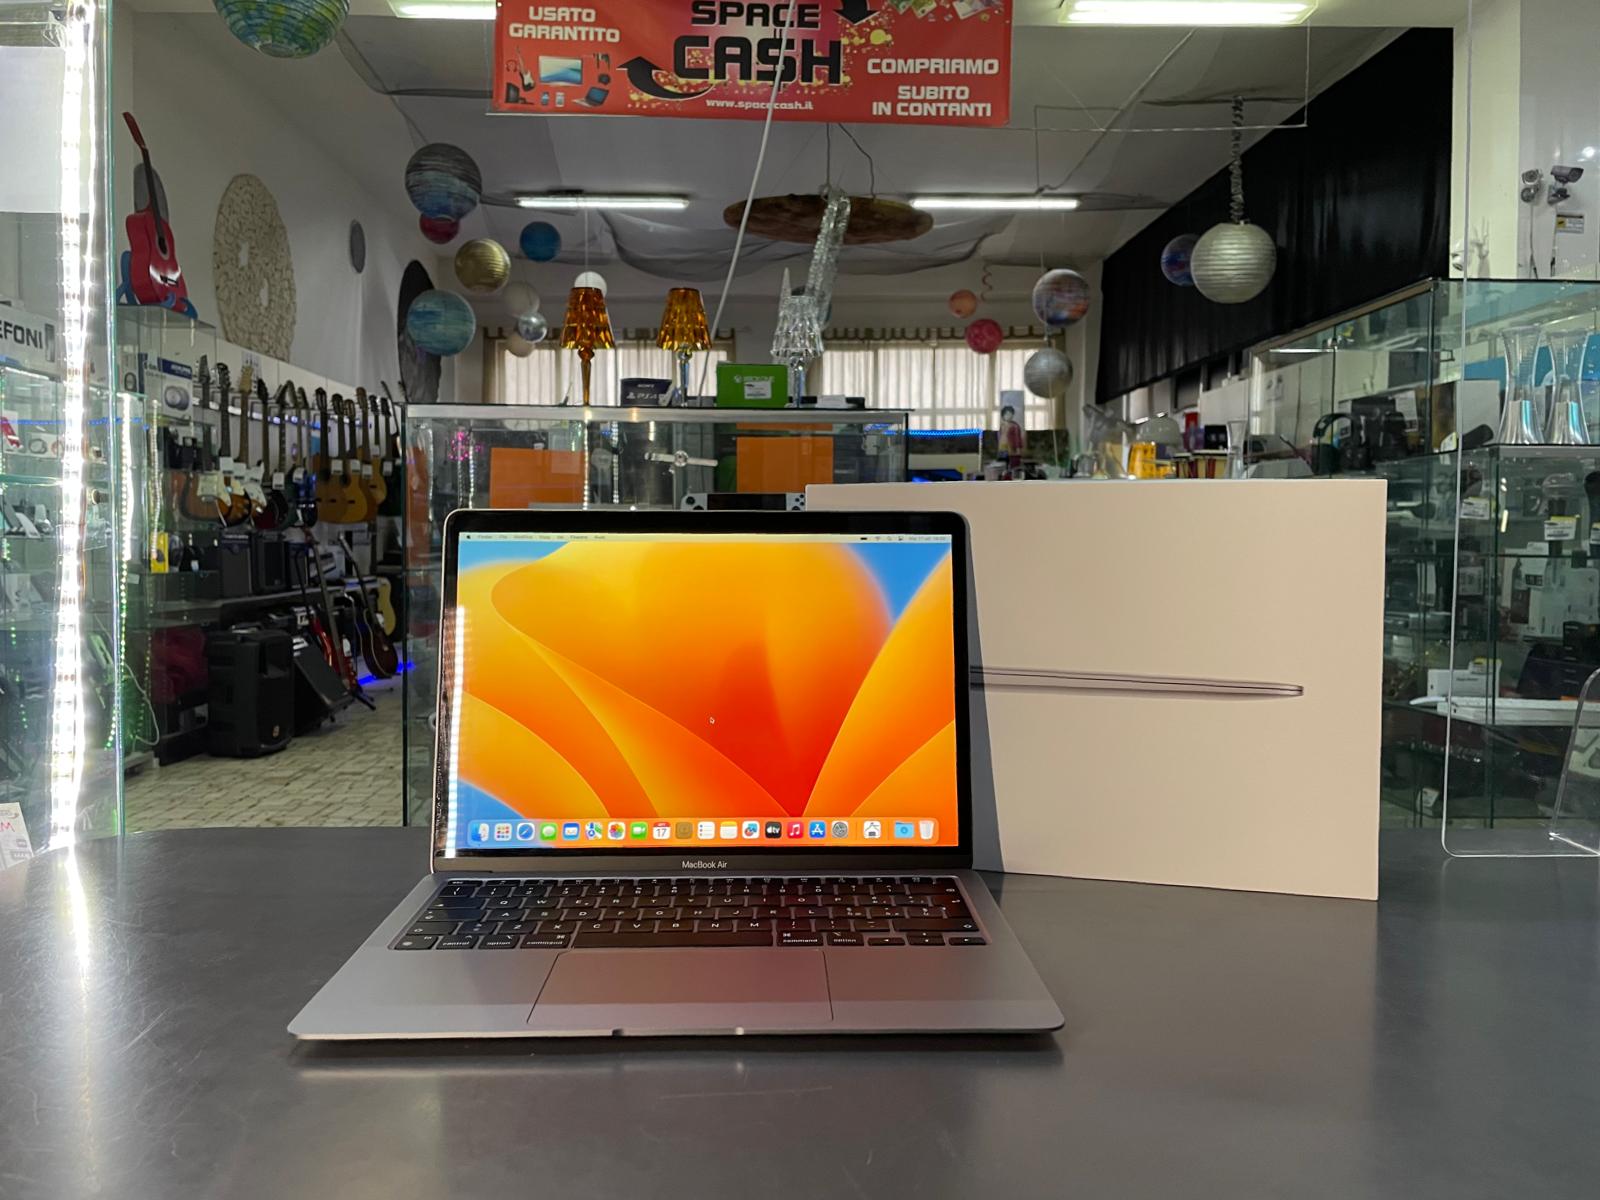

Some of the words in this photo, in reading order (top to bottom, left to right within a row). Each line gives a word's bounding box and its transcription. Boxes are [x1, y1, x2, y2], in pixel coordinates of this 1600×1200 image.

[529, 6, 596, 22] USATO
[691, 0, 821, 28] SPACE
[509, 23, 620, 42] GARANTITO
[867, 58, 999, 75] COMPRIAMO
[897, 85, 970, 100] SUBITO
[872, 101, 892, 116] IN
[896, 102, 991, 117] CONTANTI
[655, 828, 667, 838] 17
[682, 860, 716, 869] MacBook
[717, 860, 727, 869] Air
